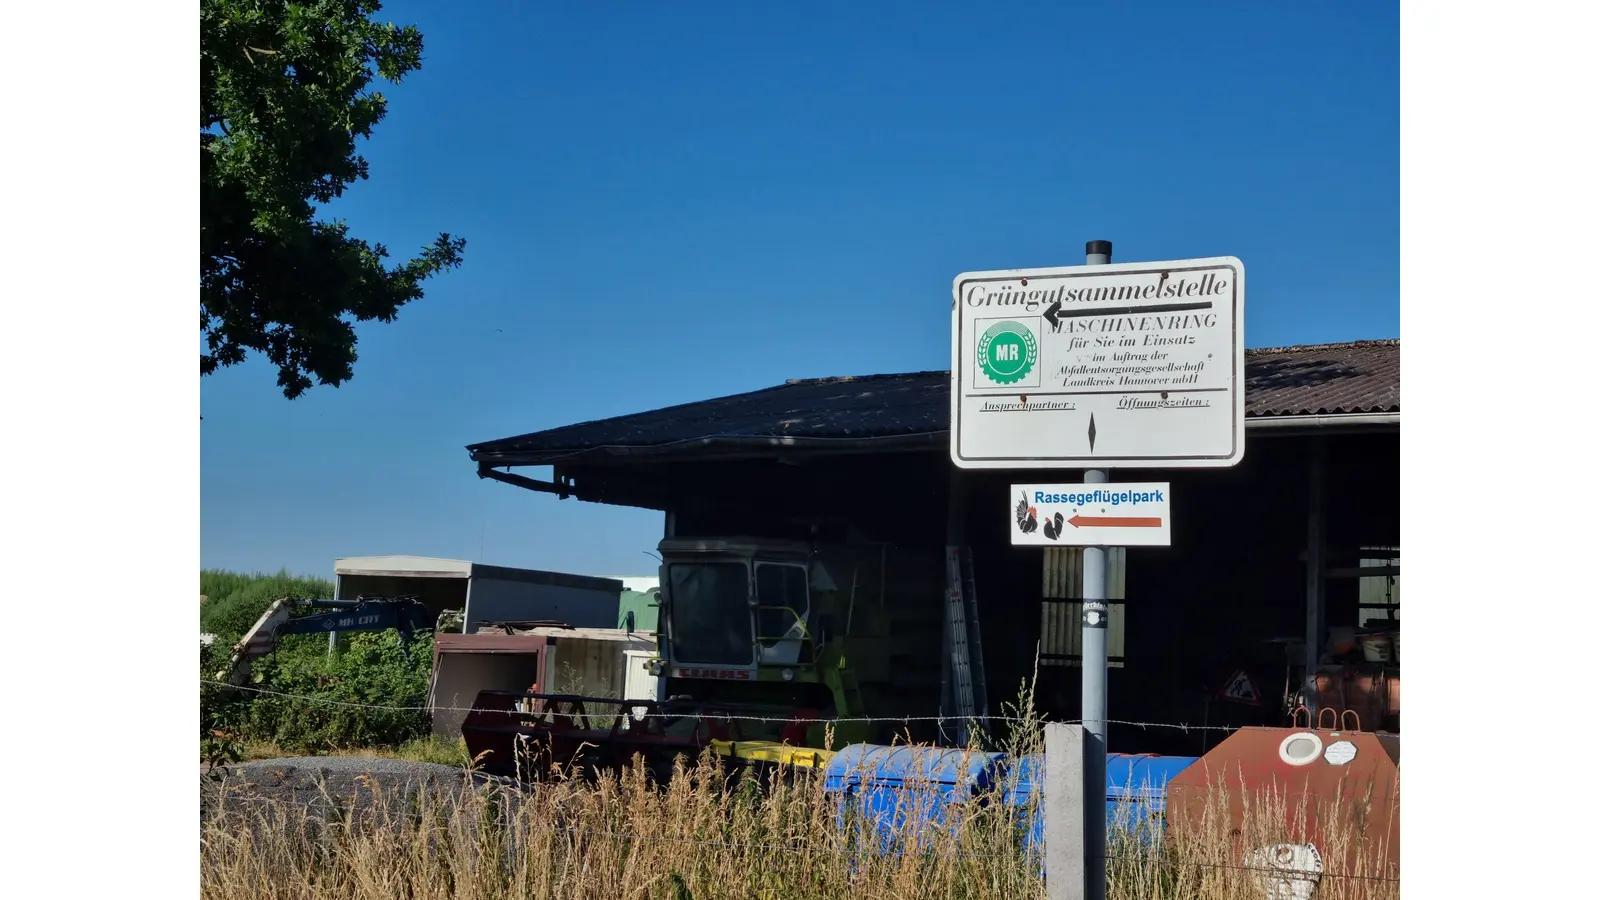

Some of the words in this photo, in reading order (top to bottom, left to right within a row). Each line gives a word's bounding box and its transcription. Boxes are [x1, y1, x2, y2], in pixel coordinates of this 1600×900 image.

[967, 273, 1228, 311] Grüngutsammelstelle
[1047, 314, 1217, 335] MASCHINENRING
[1067, 336, 1090, 352] für
[1093, 335, 1115, 348] Sie
[1119, 335, 1137, 347] im
[1142, 334, 1196, 346] Einsatz
[996, 343, 1019, 361] MR
[1092, 352, 1106, 362] im
[1111, 351, 1148, 363] Auftrag
[1150, 350, 1169, 361] der
[1058, 361, 1205, 377] Abfallentsorgungsgesellschaft
[1062, 376, 1115, 388] Landkreis
[1118, 375, 1170, 387] Hannover
[1172, 373, 1199, 385] mbH
[1034, 489, 1164, 506] Rassegeflügelpark
